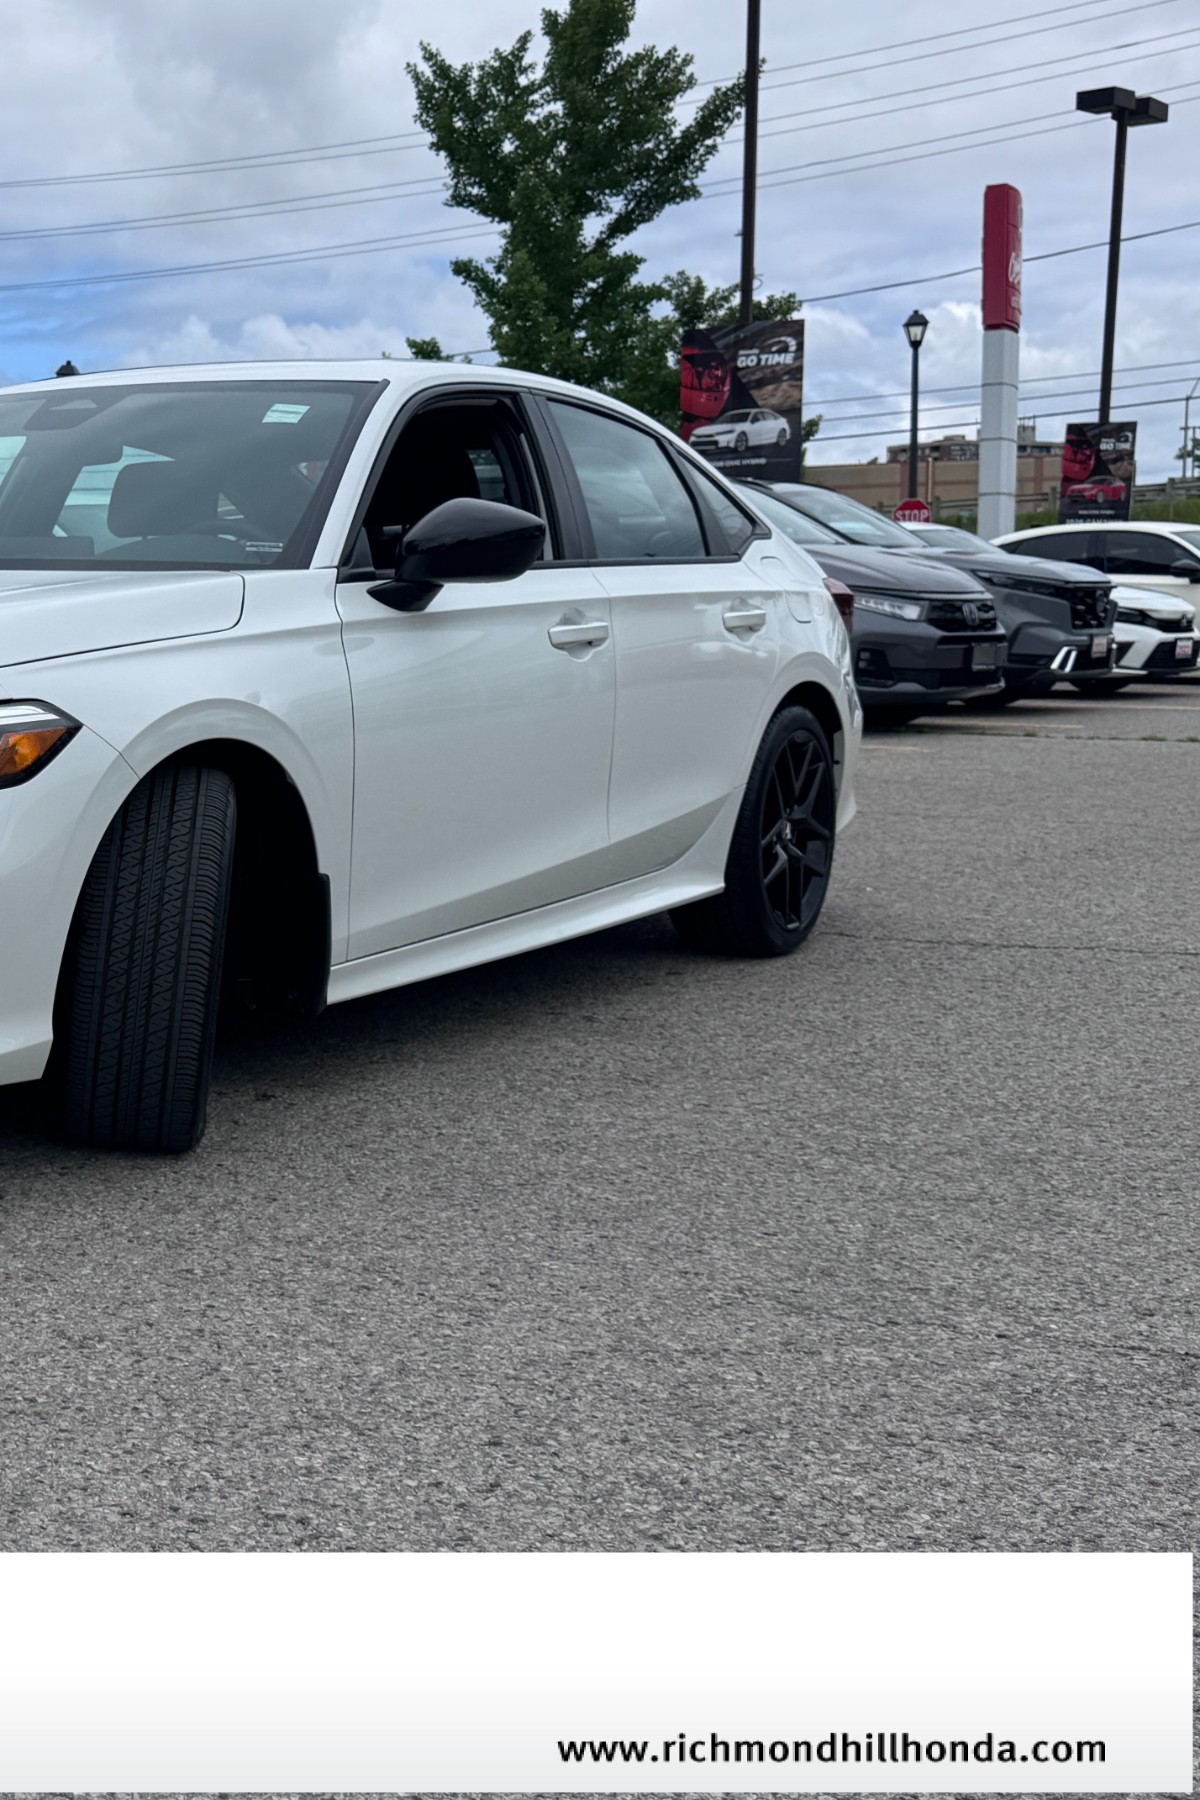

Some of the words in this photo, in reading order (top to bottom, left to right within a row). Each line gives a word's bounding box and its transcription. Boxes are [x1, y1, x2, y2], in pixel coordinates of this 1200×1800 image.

[736, 355, 758, 369] GO
[759, 352, 795, 366] TIME
[895, 509, 929, 522] STOP
